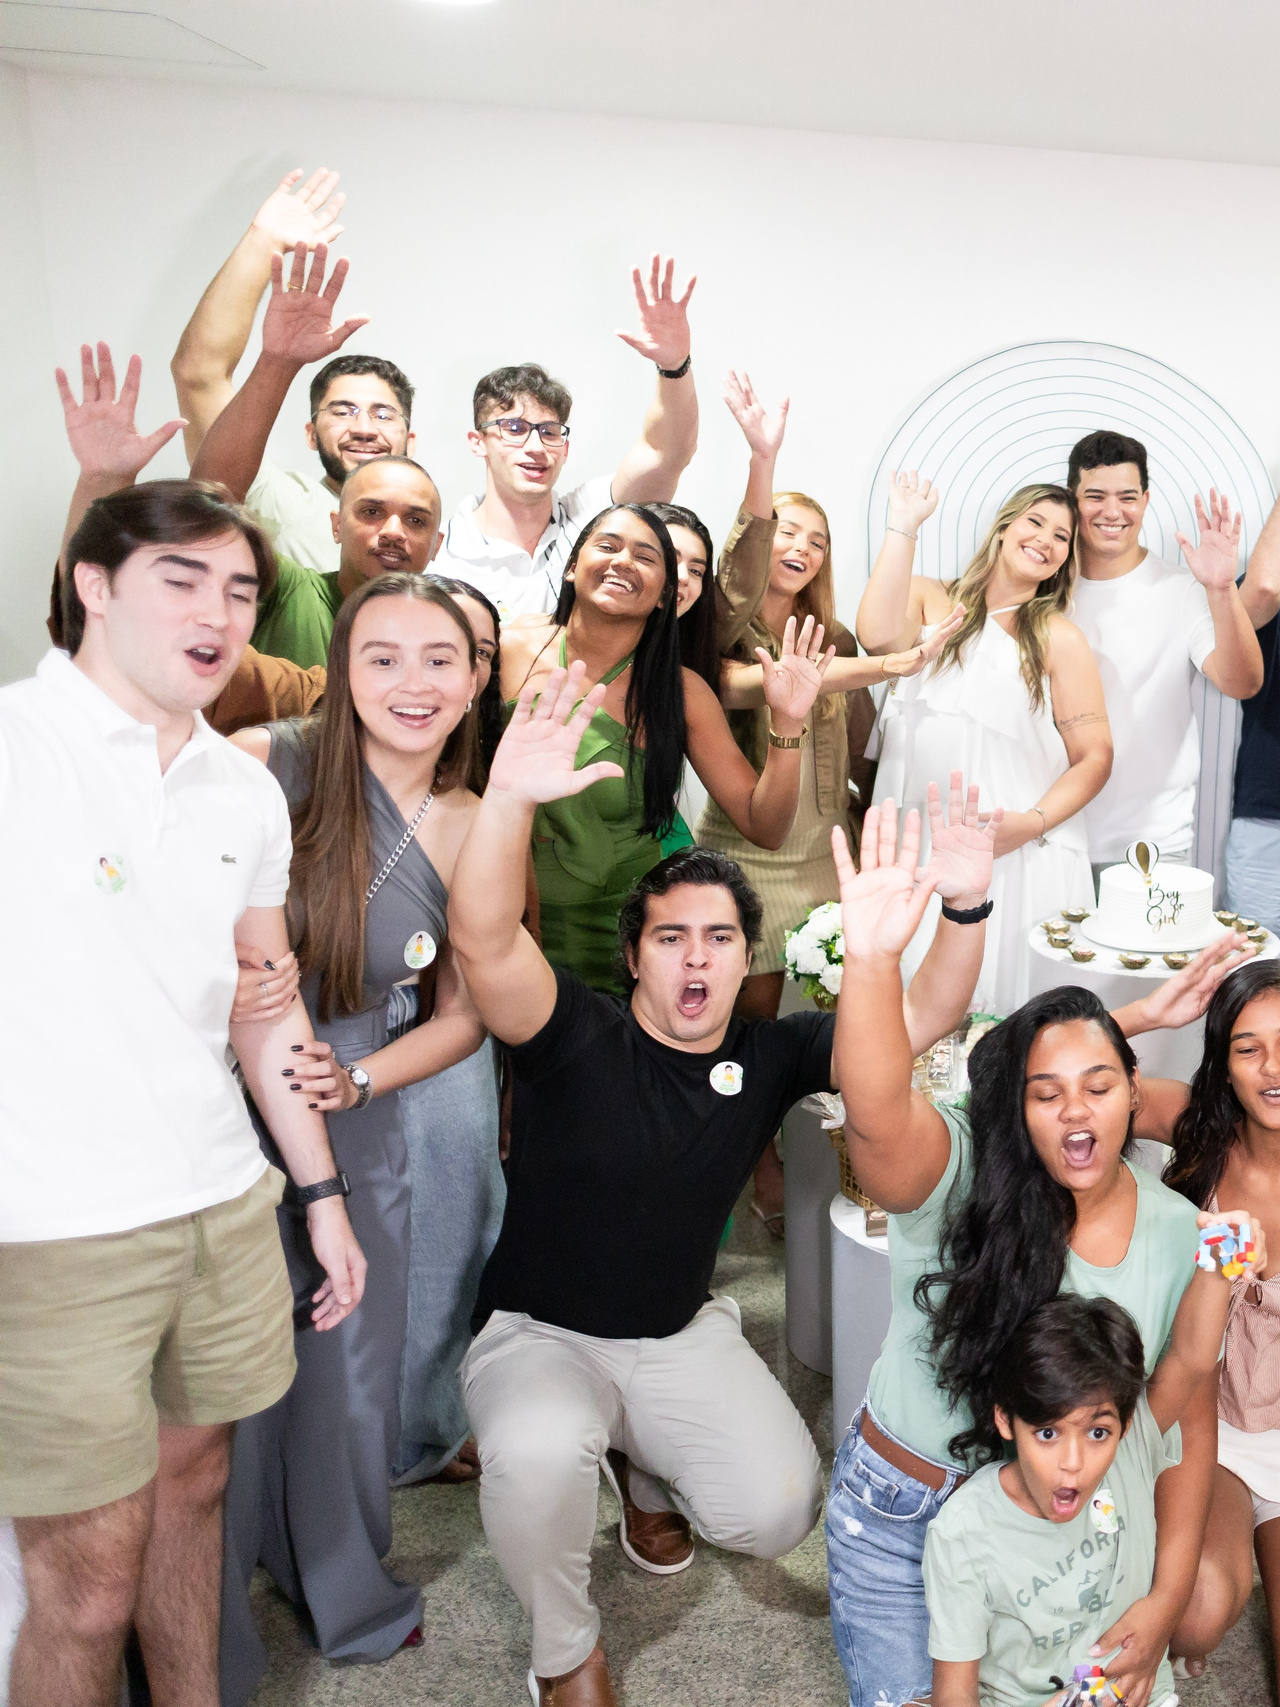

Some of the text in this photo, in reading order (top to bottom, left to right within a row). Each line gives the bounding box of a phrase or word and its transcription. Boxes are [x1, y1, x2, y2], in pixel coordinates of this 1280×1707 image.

[1146, 883, 1182, 908] Boy
[1173, 904, 1185, 912] or
[1146, 905, 1181, 934] Girl
